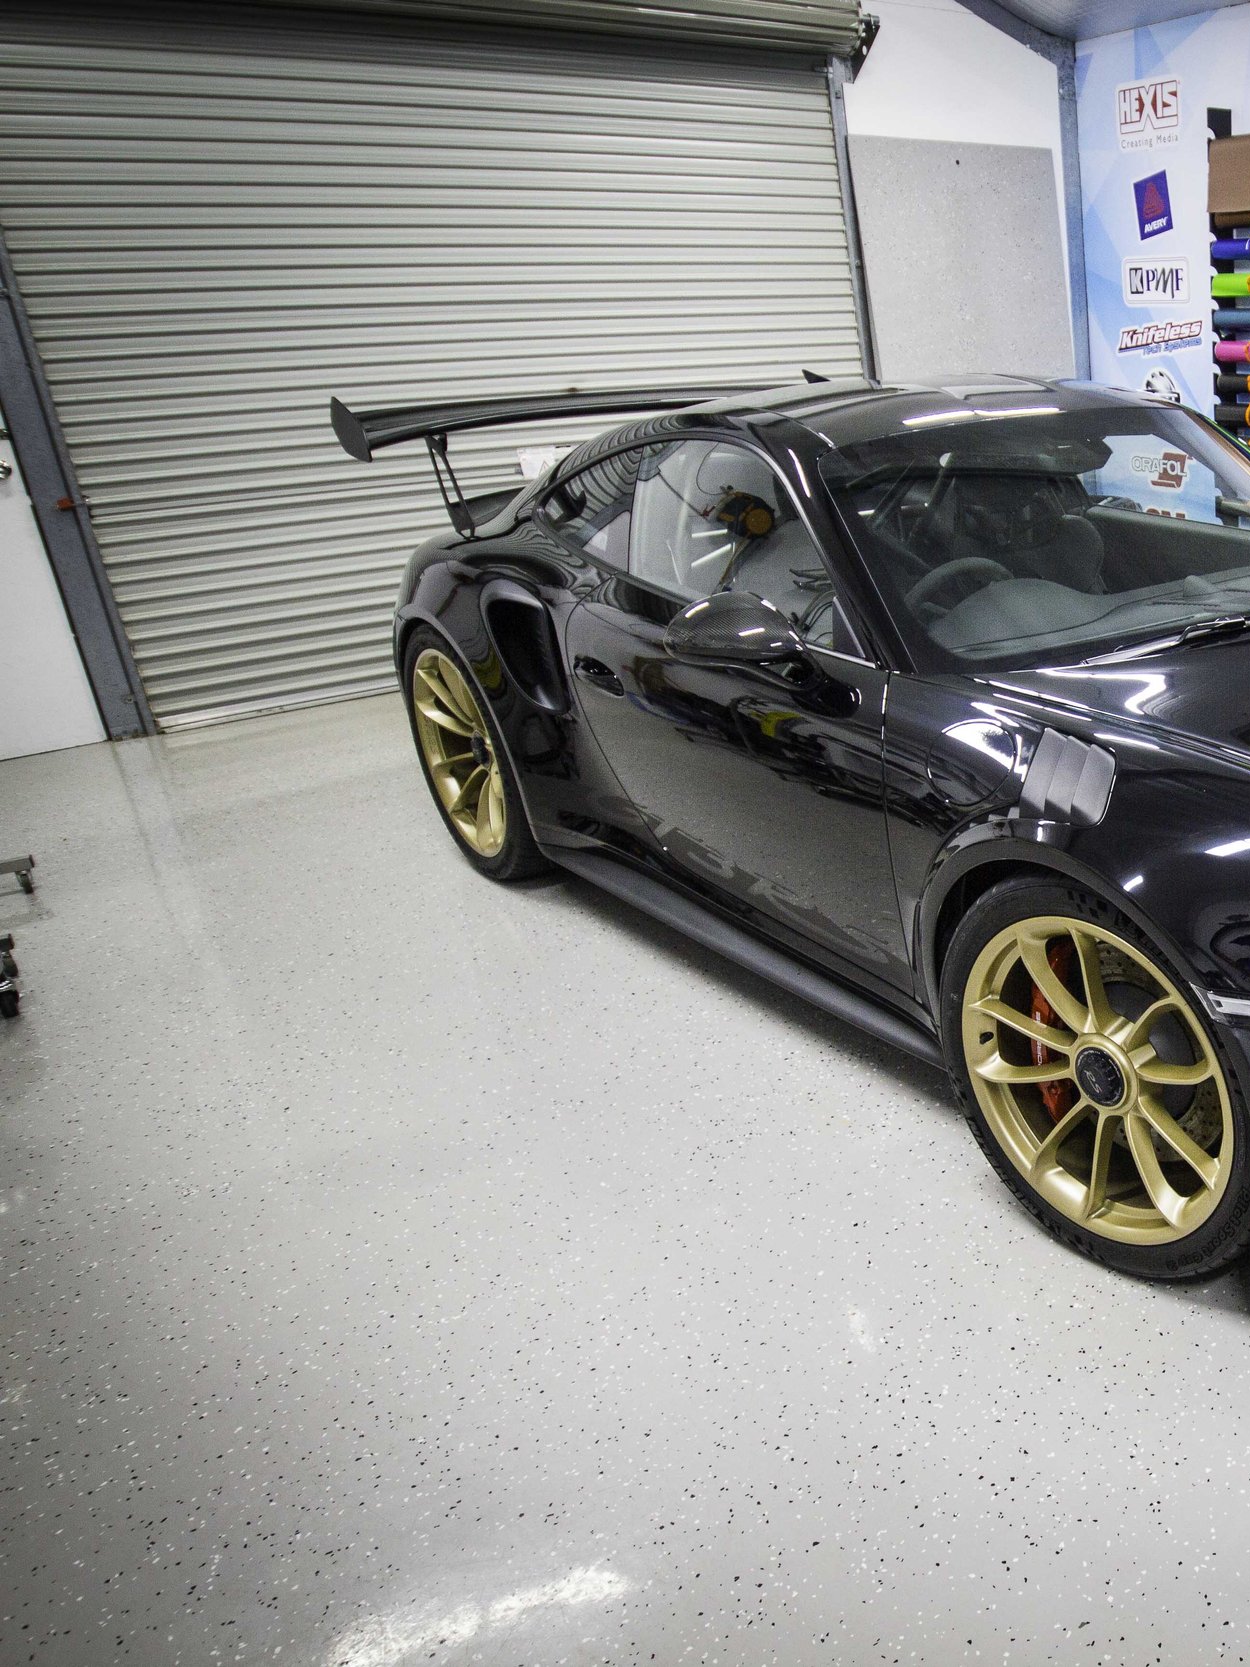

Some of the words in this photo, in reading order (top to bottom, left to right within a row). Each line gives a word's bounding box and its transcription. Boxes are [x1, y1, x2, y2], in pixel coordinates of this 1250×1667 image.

[1118, 80, 1178, 134] HEXIS
[1121, 138, 1153, 149] Creating
[1156, 134, 1178, 144] Media
[1144, 216, 1168, 234] AVERY
[1129, 267, 1184, 299] KPMF
[1119, 321, 1202, 350] Knifeless
[1131, 456, 1187, 477] ORAFOL
